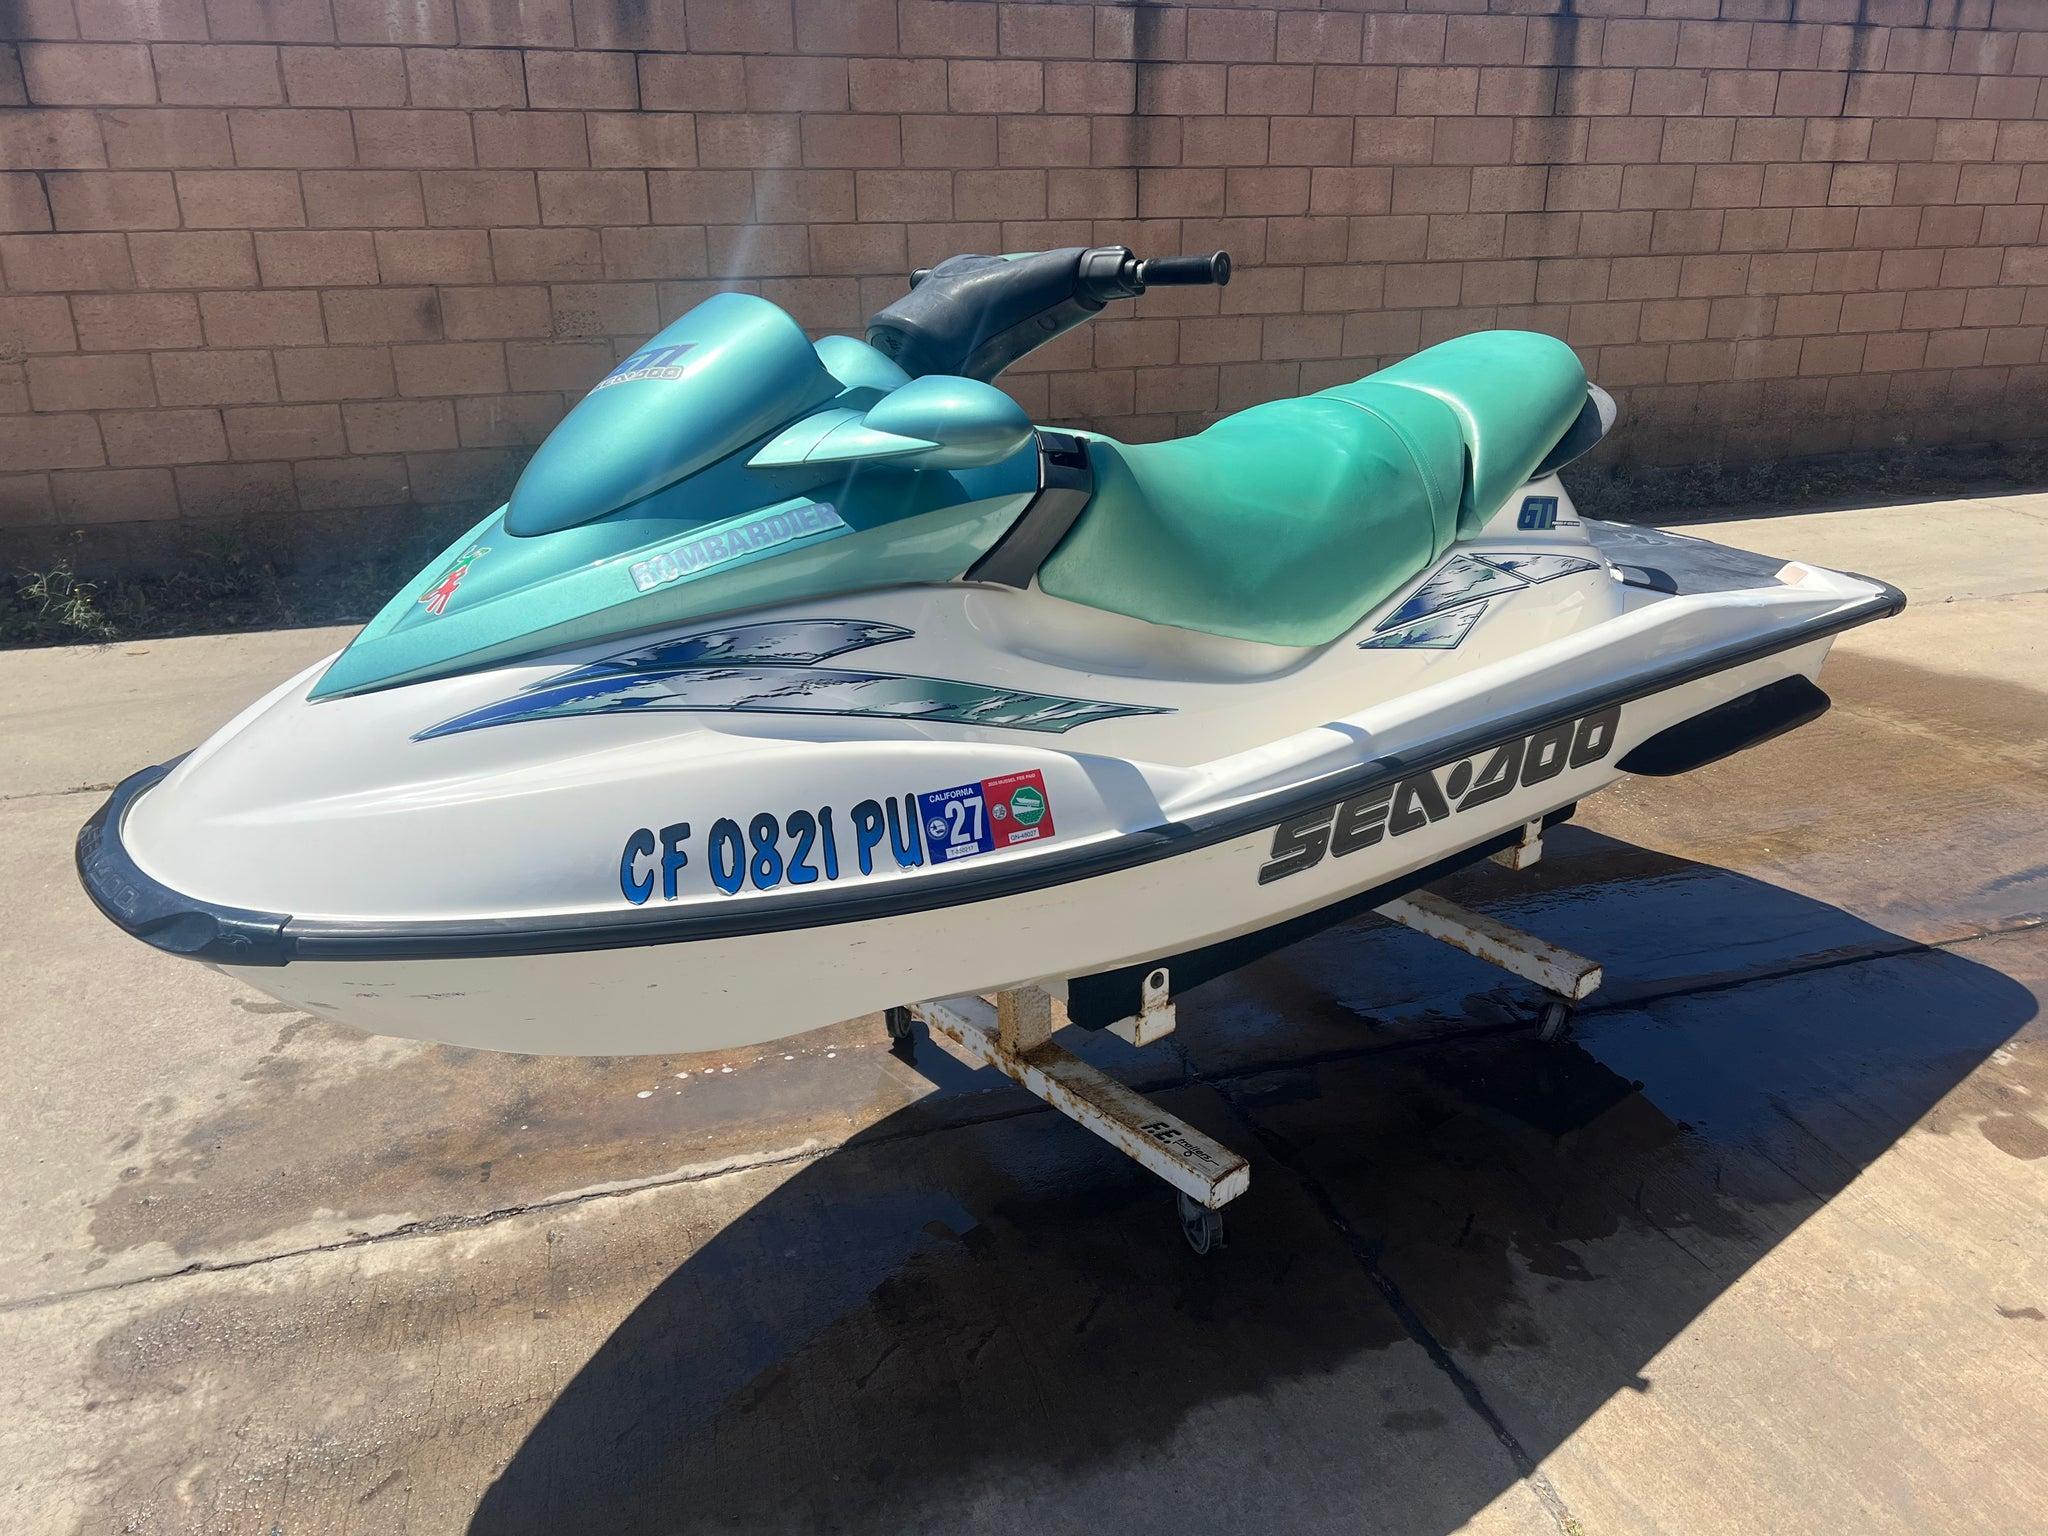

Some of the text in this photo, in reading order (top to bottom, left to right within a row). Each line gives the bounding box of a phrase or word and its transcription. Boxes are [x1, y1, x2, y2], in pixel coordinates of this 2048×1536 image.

[1518, 496, 1558, 531] GTI
[929, 787, 974, 803] CALIFORNIA
[944, 795, 983, 845] 27
[620, 793, 925, 905] CF 0821 PU
[1178, 1138, 1212, 1160] trailers
